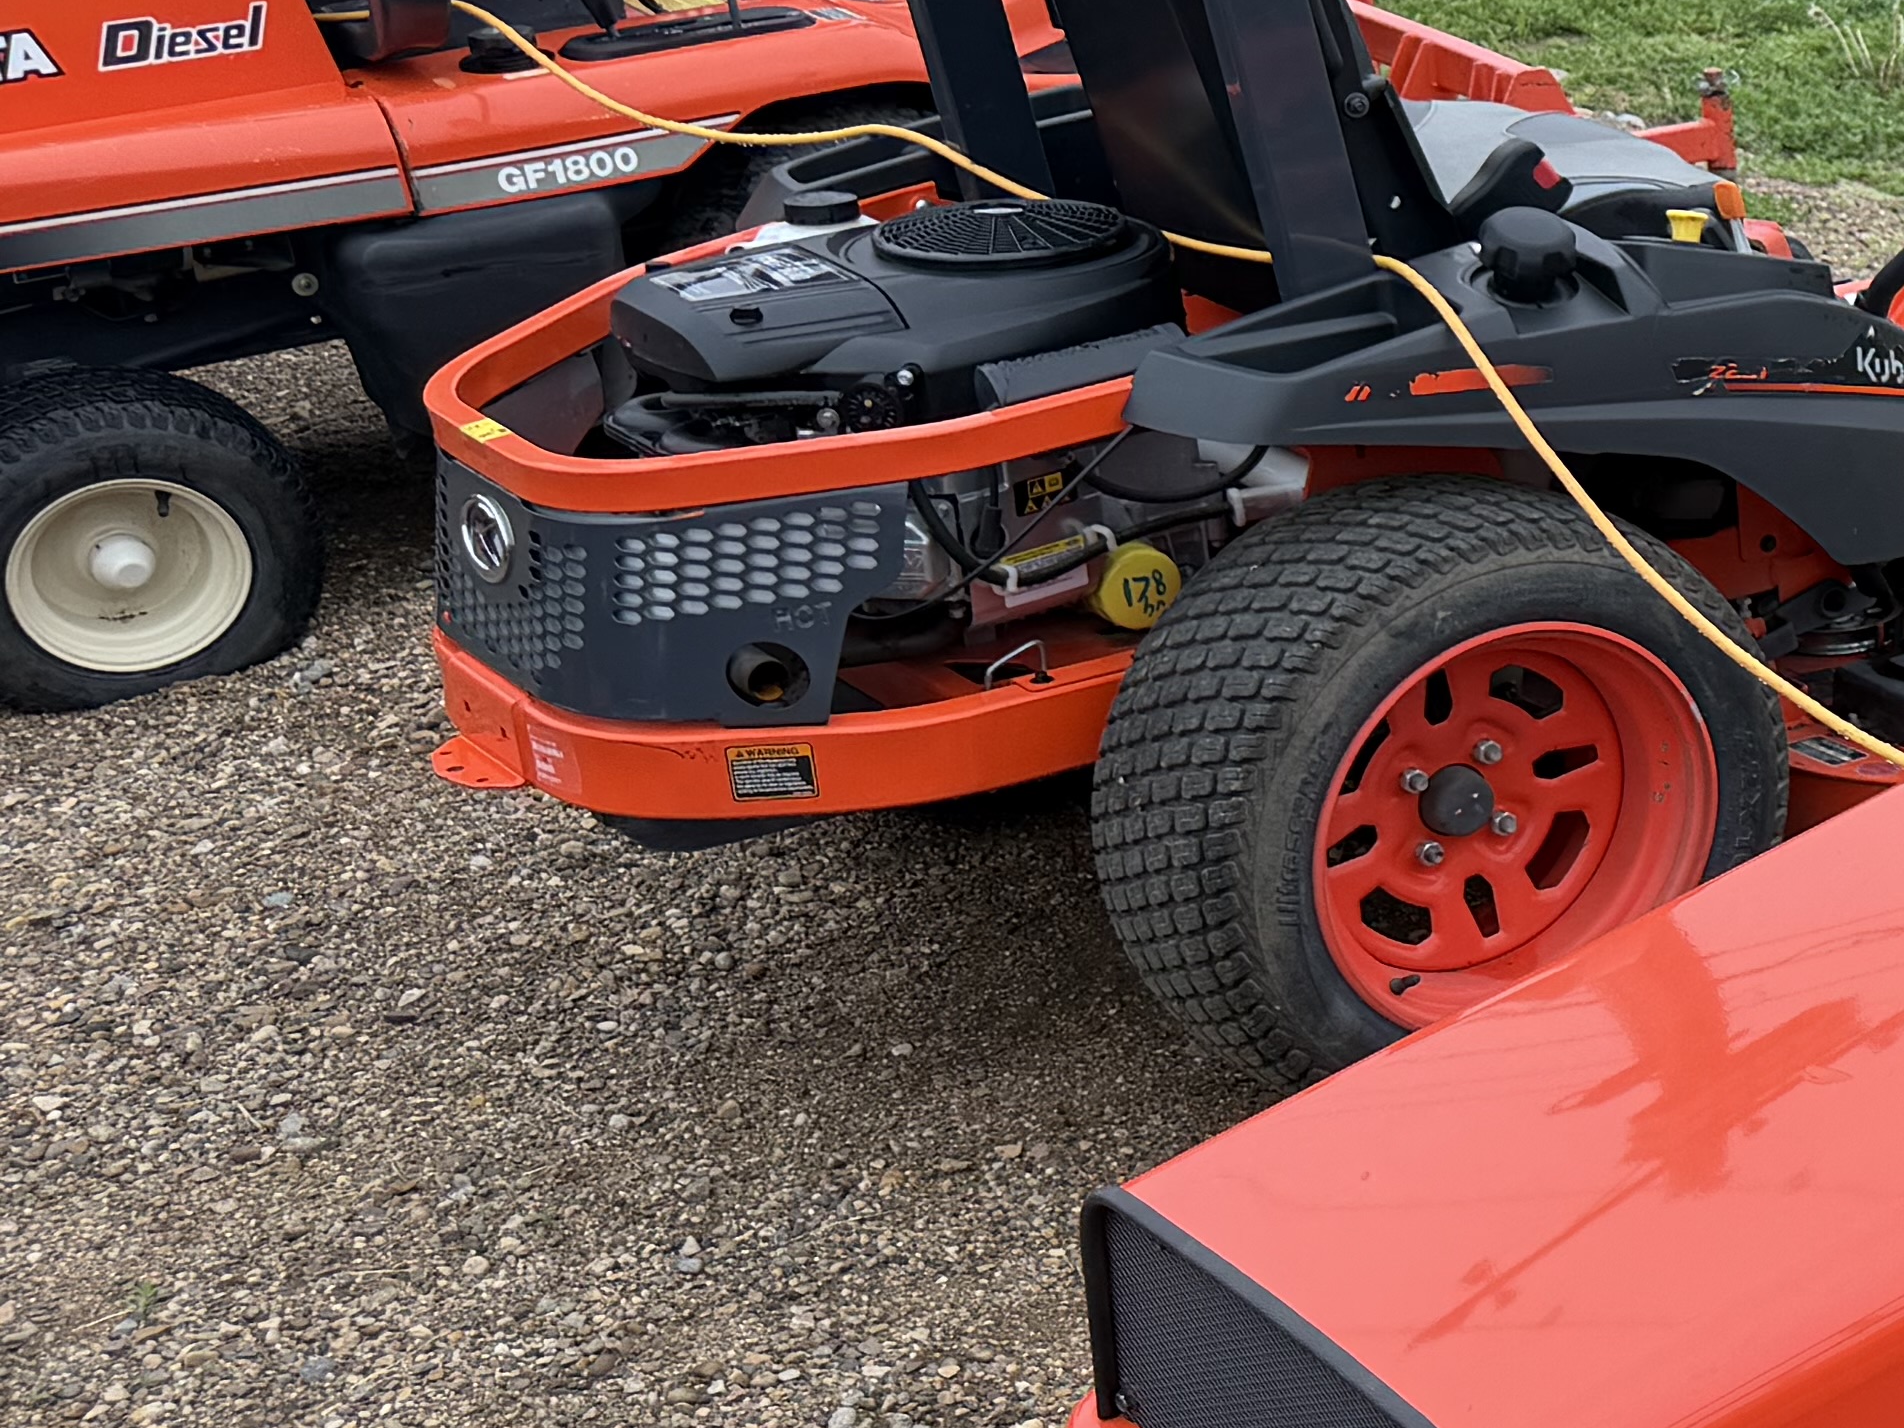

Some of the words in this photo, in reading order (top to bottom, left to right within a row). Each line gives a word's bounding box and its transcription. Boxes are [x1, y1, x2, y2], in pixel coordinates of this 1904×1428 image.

[99, 1, 267, 71] Diesel
[497, 146, 638, 193] GF1800
[746, 747, 800, 758] WARNING
